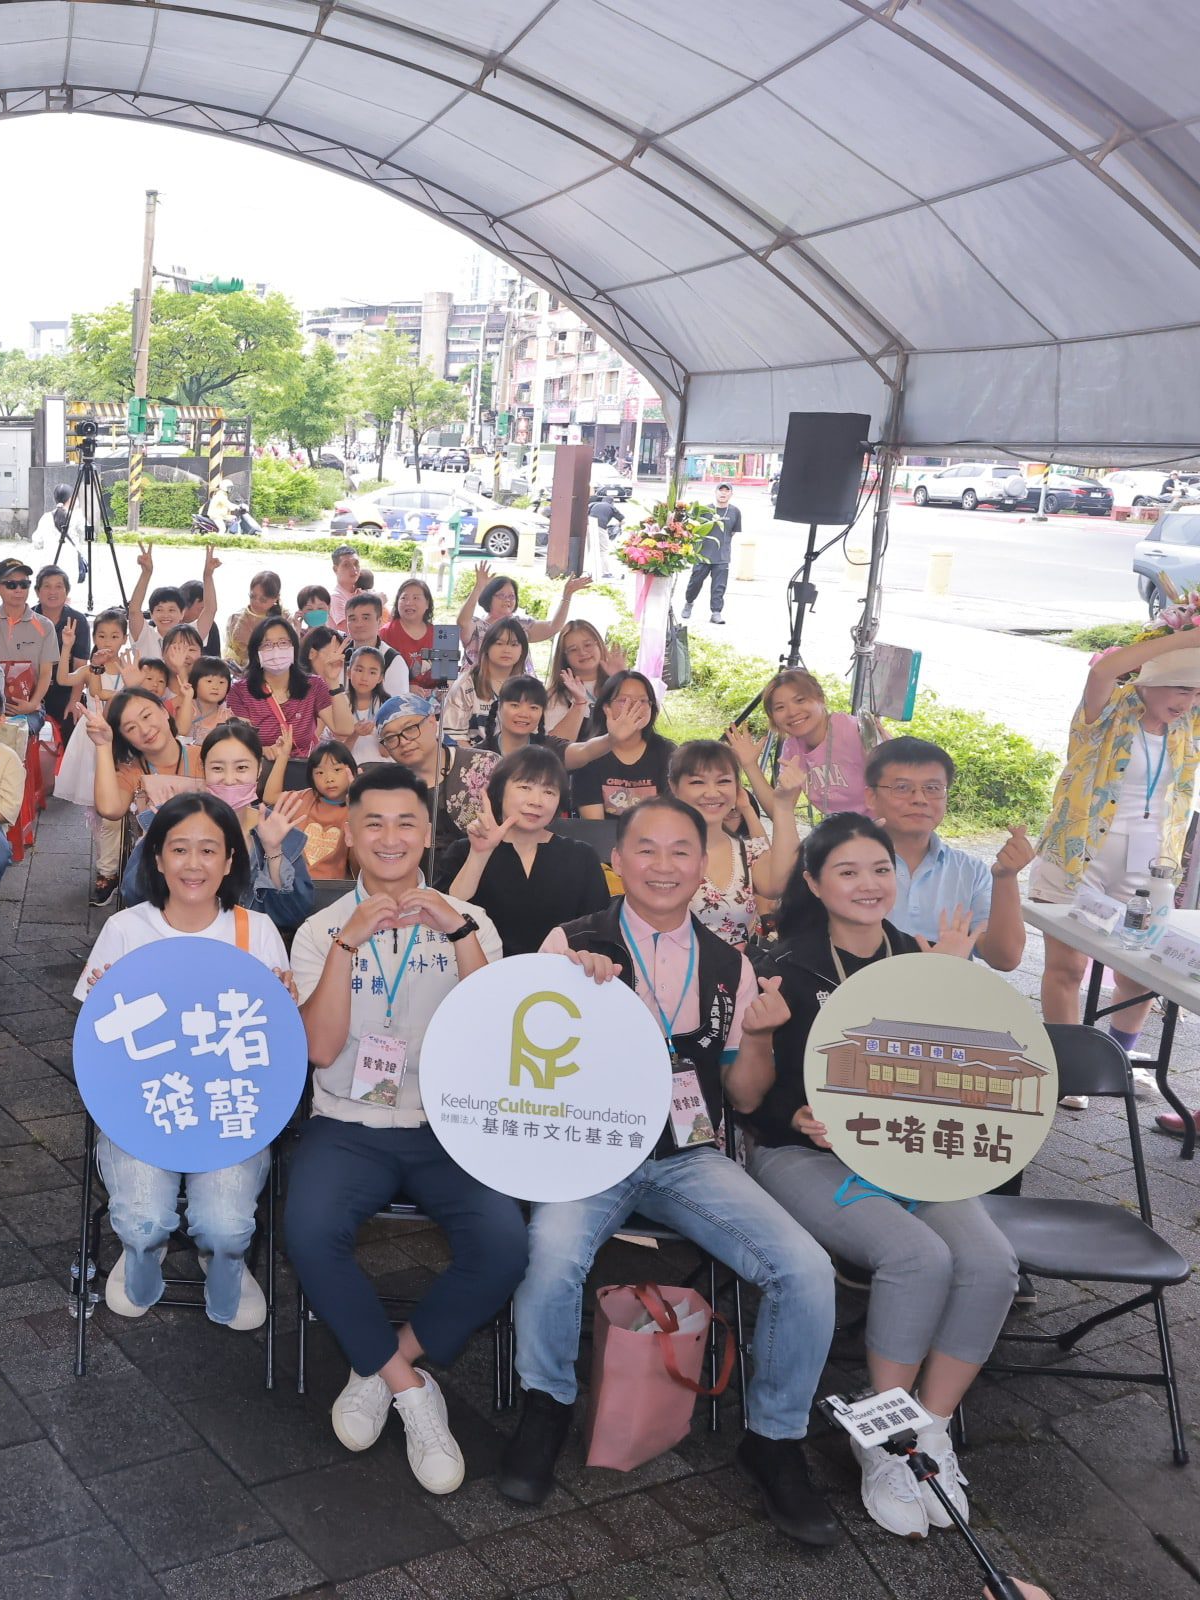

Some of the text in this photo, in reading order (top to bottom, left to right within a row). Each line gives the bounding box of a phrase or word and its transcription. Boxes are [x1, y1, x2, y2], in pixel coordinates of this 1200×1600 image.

[94, 988, 270, 1072] 七堵
[888, 1041, 965, 1061] 七堵車站
[141, 1071, 261, 1140] 發聲
[440, 1112, 645, 1149] 財團法人 基隆市文化基金會
[845, 1112, 1014, 1164] 七堵車站
[856, 1406, 919, 1436] 吉隆新聞
